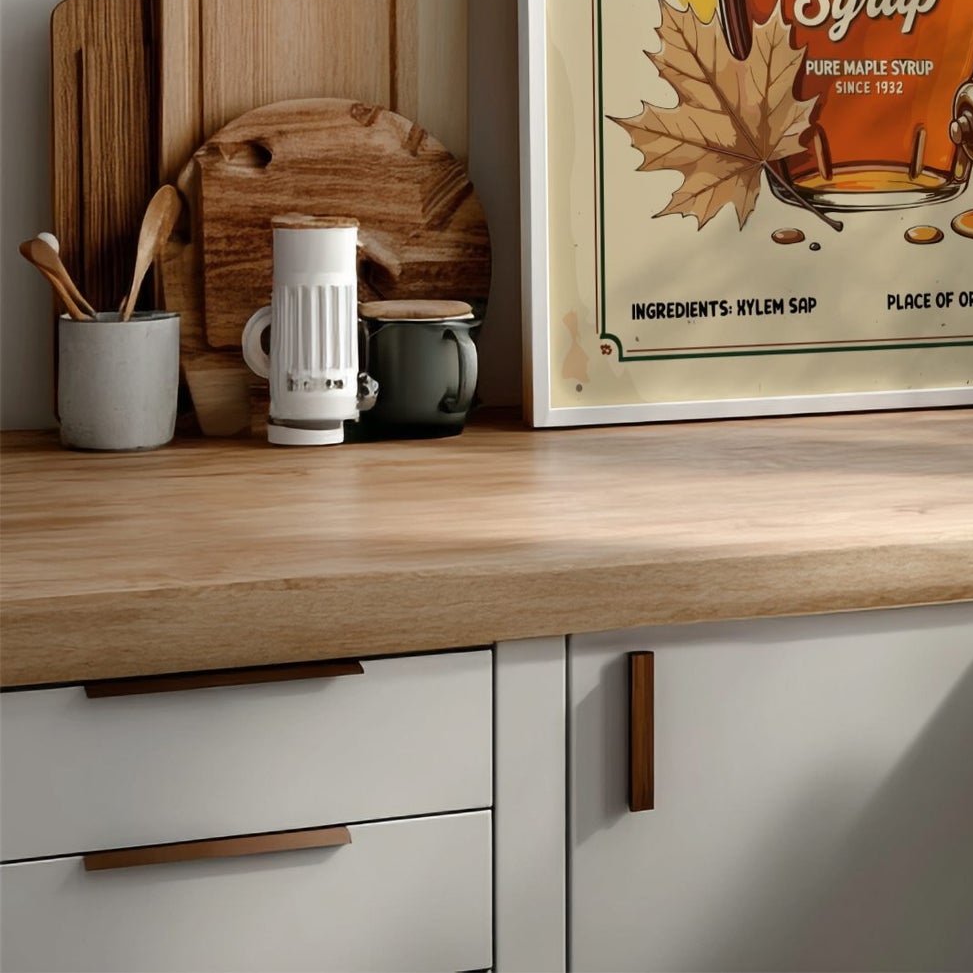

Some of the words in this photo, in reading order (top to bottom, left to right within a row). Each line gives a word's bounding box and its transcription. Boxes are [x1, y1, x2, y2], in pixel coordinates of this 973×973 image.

[805, 59, 841, 76] PURE
[843, 60, 888, 76] MAPLE
[890, 60, 934, 76] SYRUP
[835, 81, 871, 94] SINCE
[875, 81, 904, 94] 1932
[631, 300, 733, 320] INGREDIENTS:
[789, 297, 817, 314] SAP
[887, 293, 932, 310] PLACE
[935, 291, 954, 308] OF
